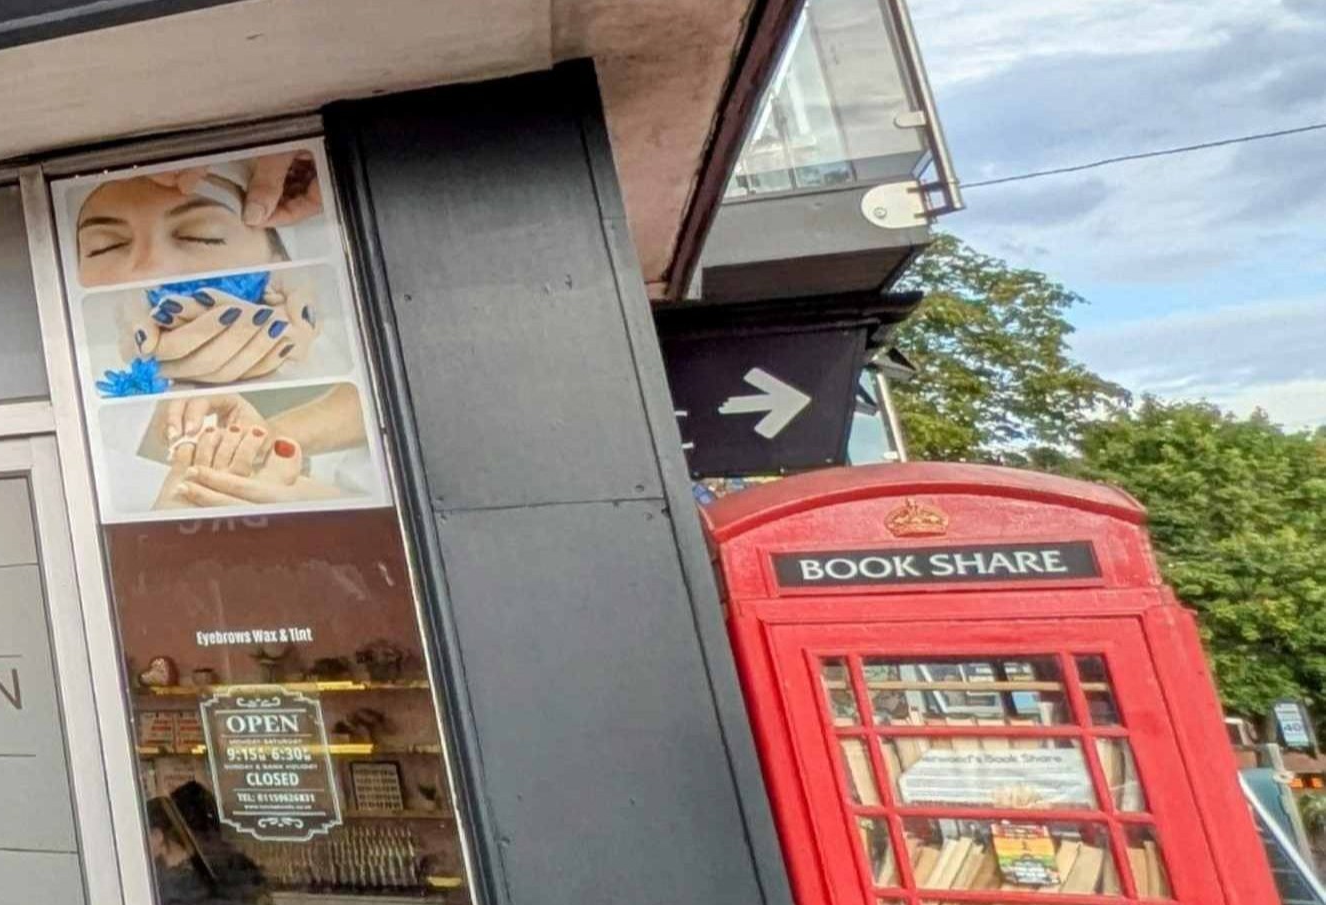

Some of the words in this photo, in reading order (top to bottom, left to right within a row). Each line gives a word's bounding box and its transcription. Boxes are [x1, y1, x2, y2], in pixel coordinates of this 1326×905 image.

[799, 555, 923, 580] BOOK
[929, 550, 1069, 577] SHARE
[196, 630, 251, 647] Eyebrows
[251, 629, 278, 644] Wax
[279, 628, 289, 643] &
[226, 714, 300, 733] OPEN
[246, 772, 299, 786] CLOSED
[237, 793, 256, 803] TEL:
